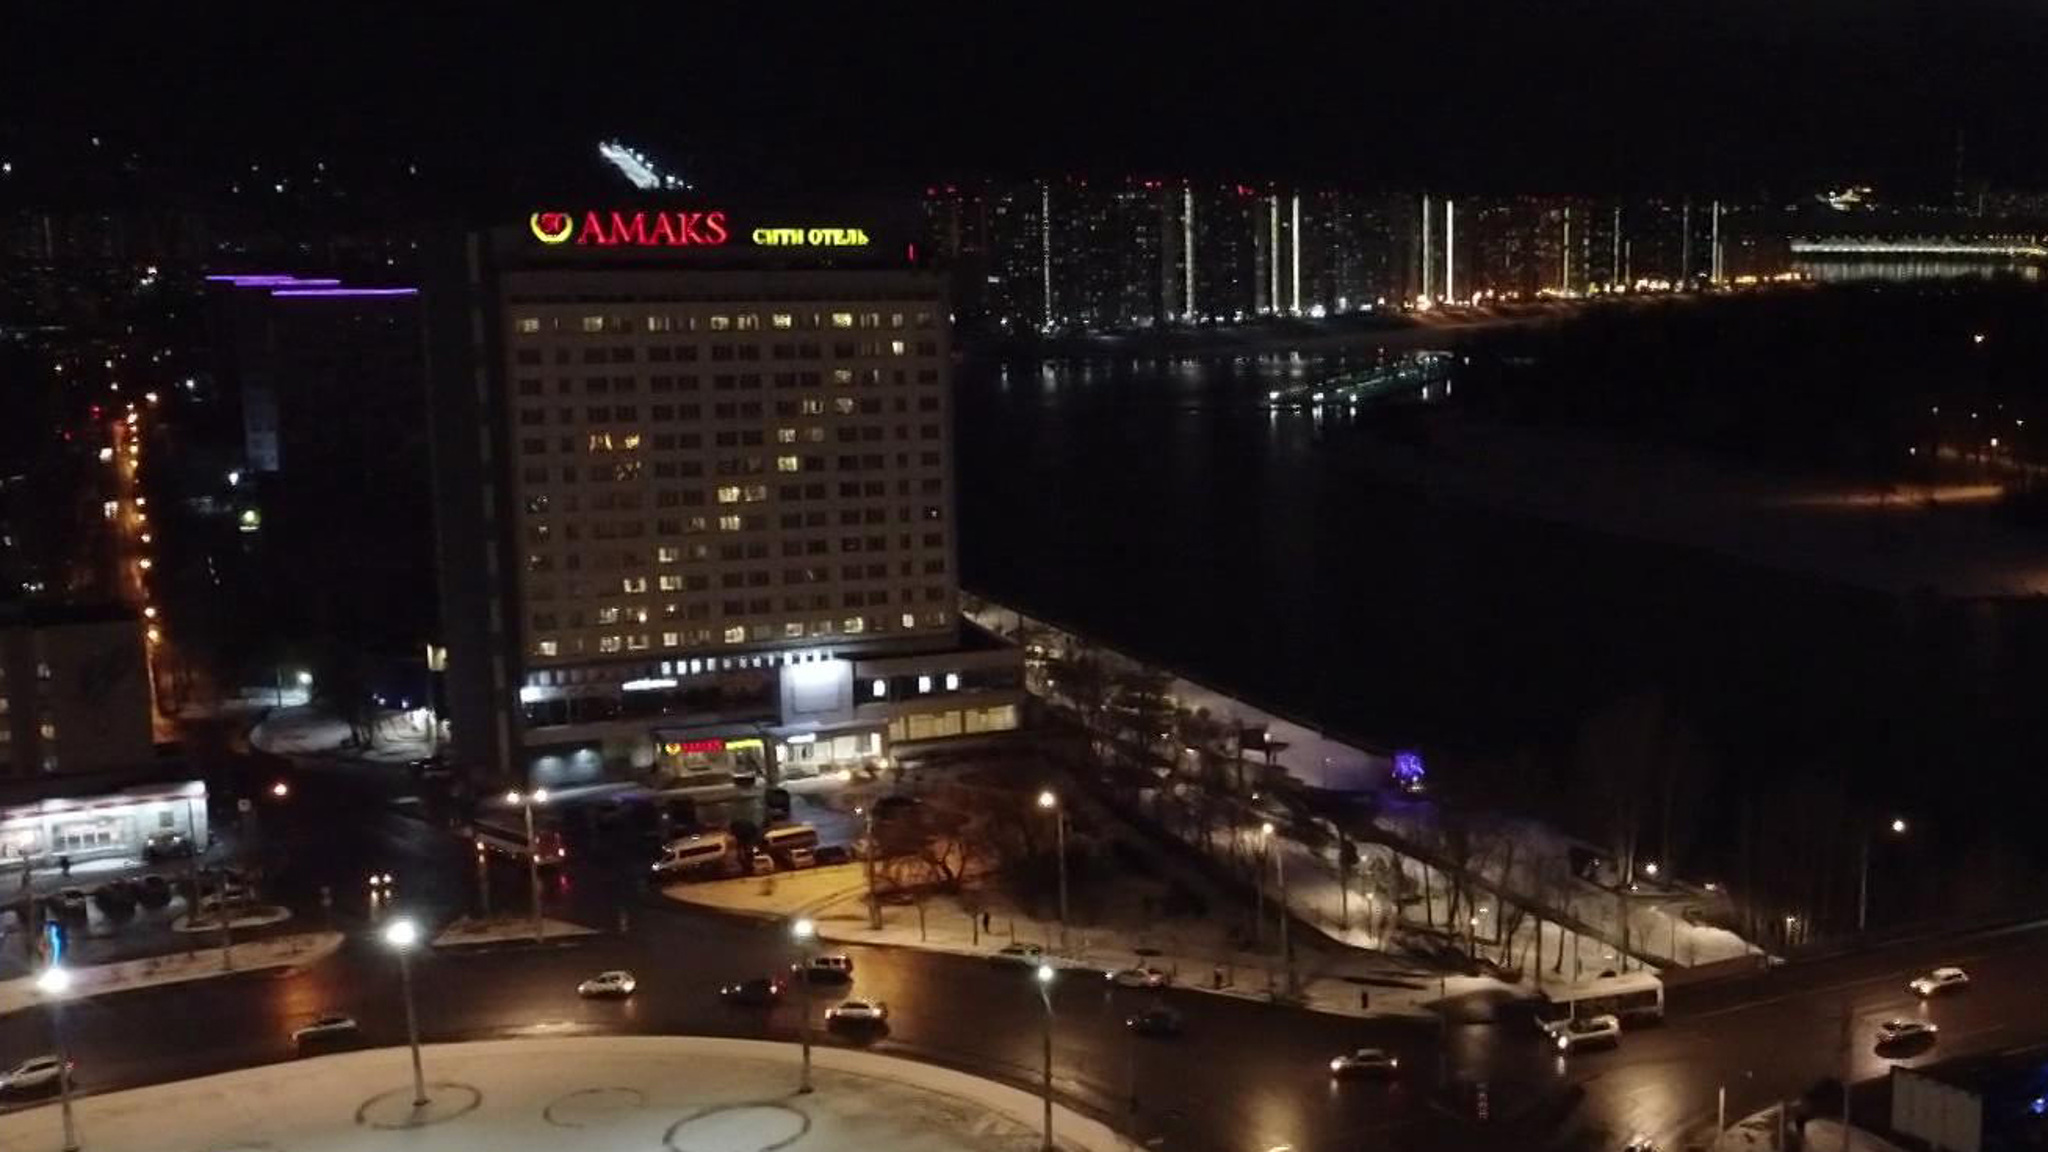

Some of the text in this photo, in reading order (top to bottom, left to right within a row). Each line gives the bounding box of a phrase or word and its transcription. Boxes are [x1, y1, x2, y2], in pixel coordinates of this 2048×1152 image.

[576, 210, 727, 246] AMAKS
[753, 228, 869, 246] СИТИ ОТЕЛЬ
